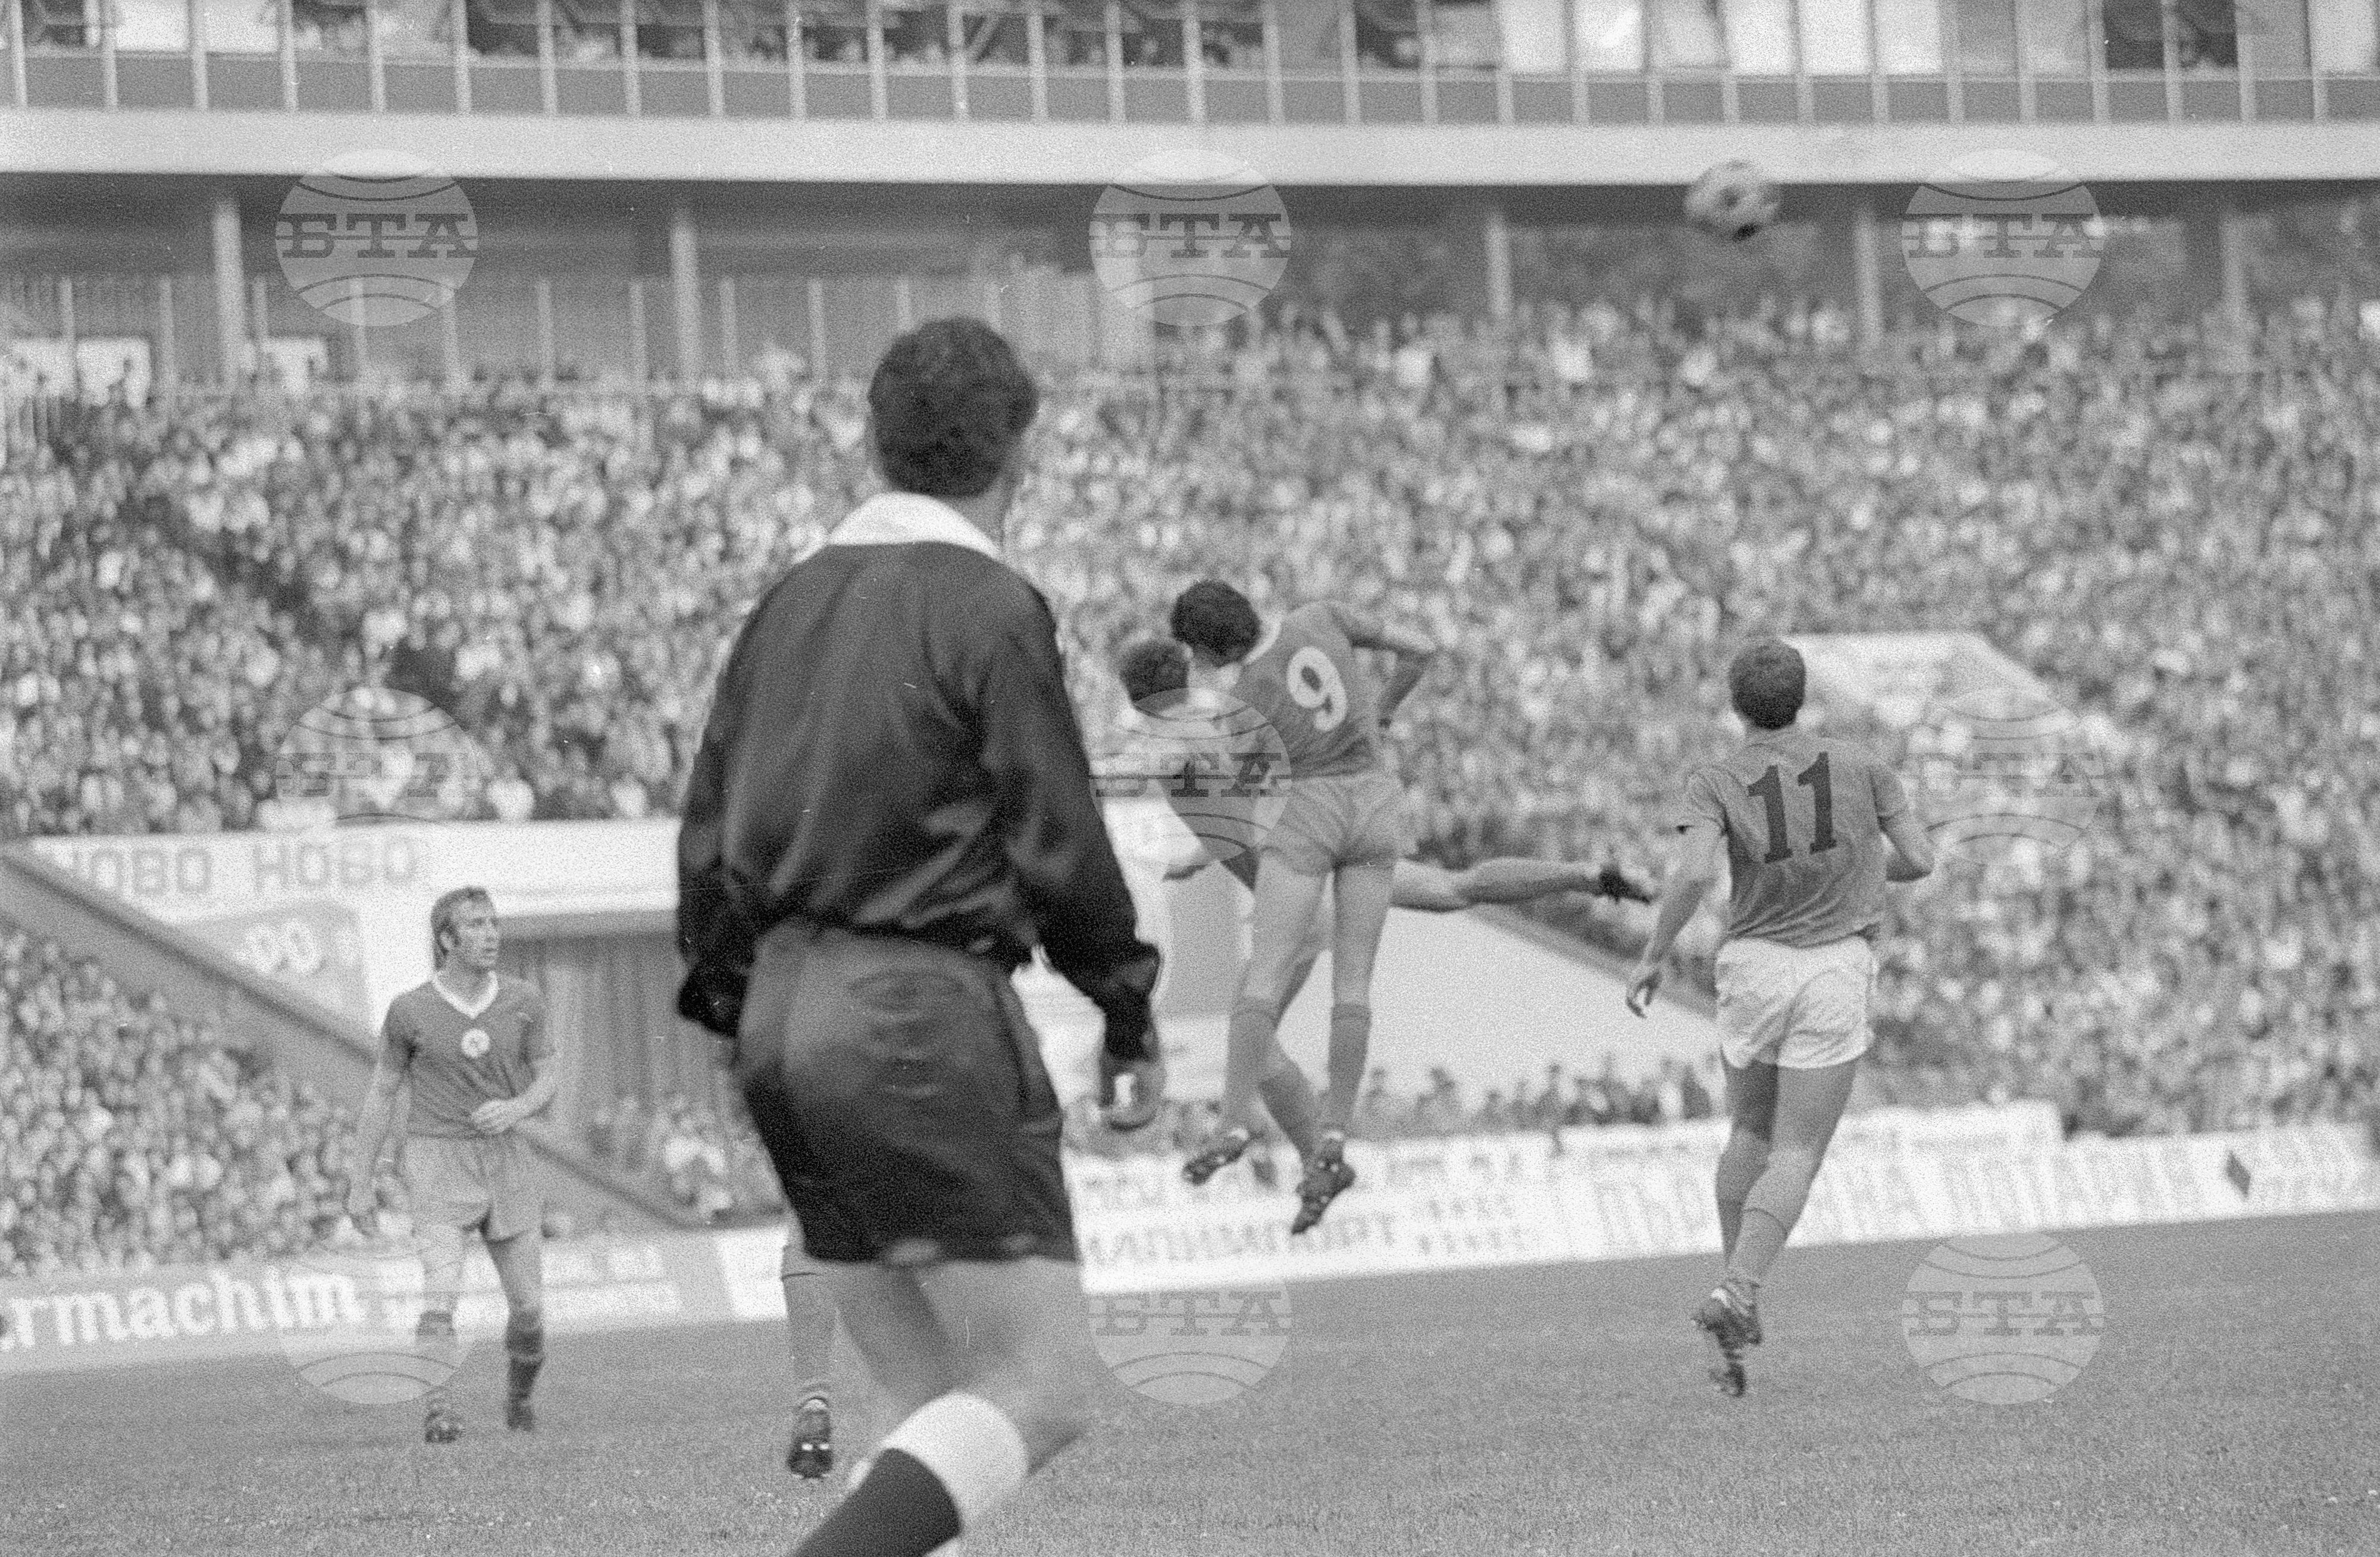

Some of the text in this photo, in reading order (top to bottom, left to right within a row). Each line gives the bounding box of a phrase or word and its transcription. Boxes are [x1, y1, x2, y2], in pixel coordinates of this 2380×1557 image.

[1287, 646, 1347, 731] 9
[1747, 752, 1836, 864] 11
[71, 835, 419, 896] ОВО НОВО
[0, 1265, 368, 1352] rmachim
